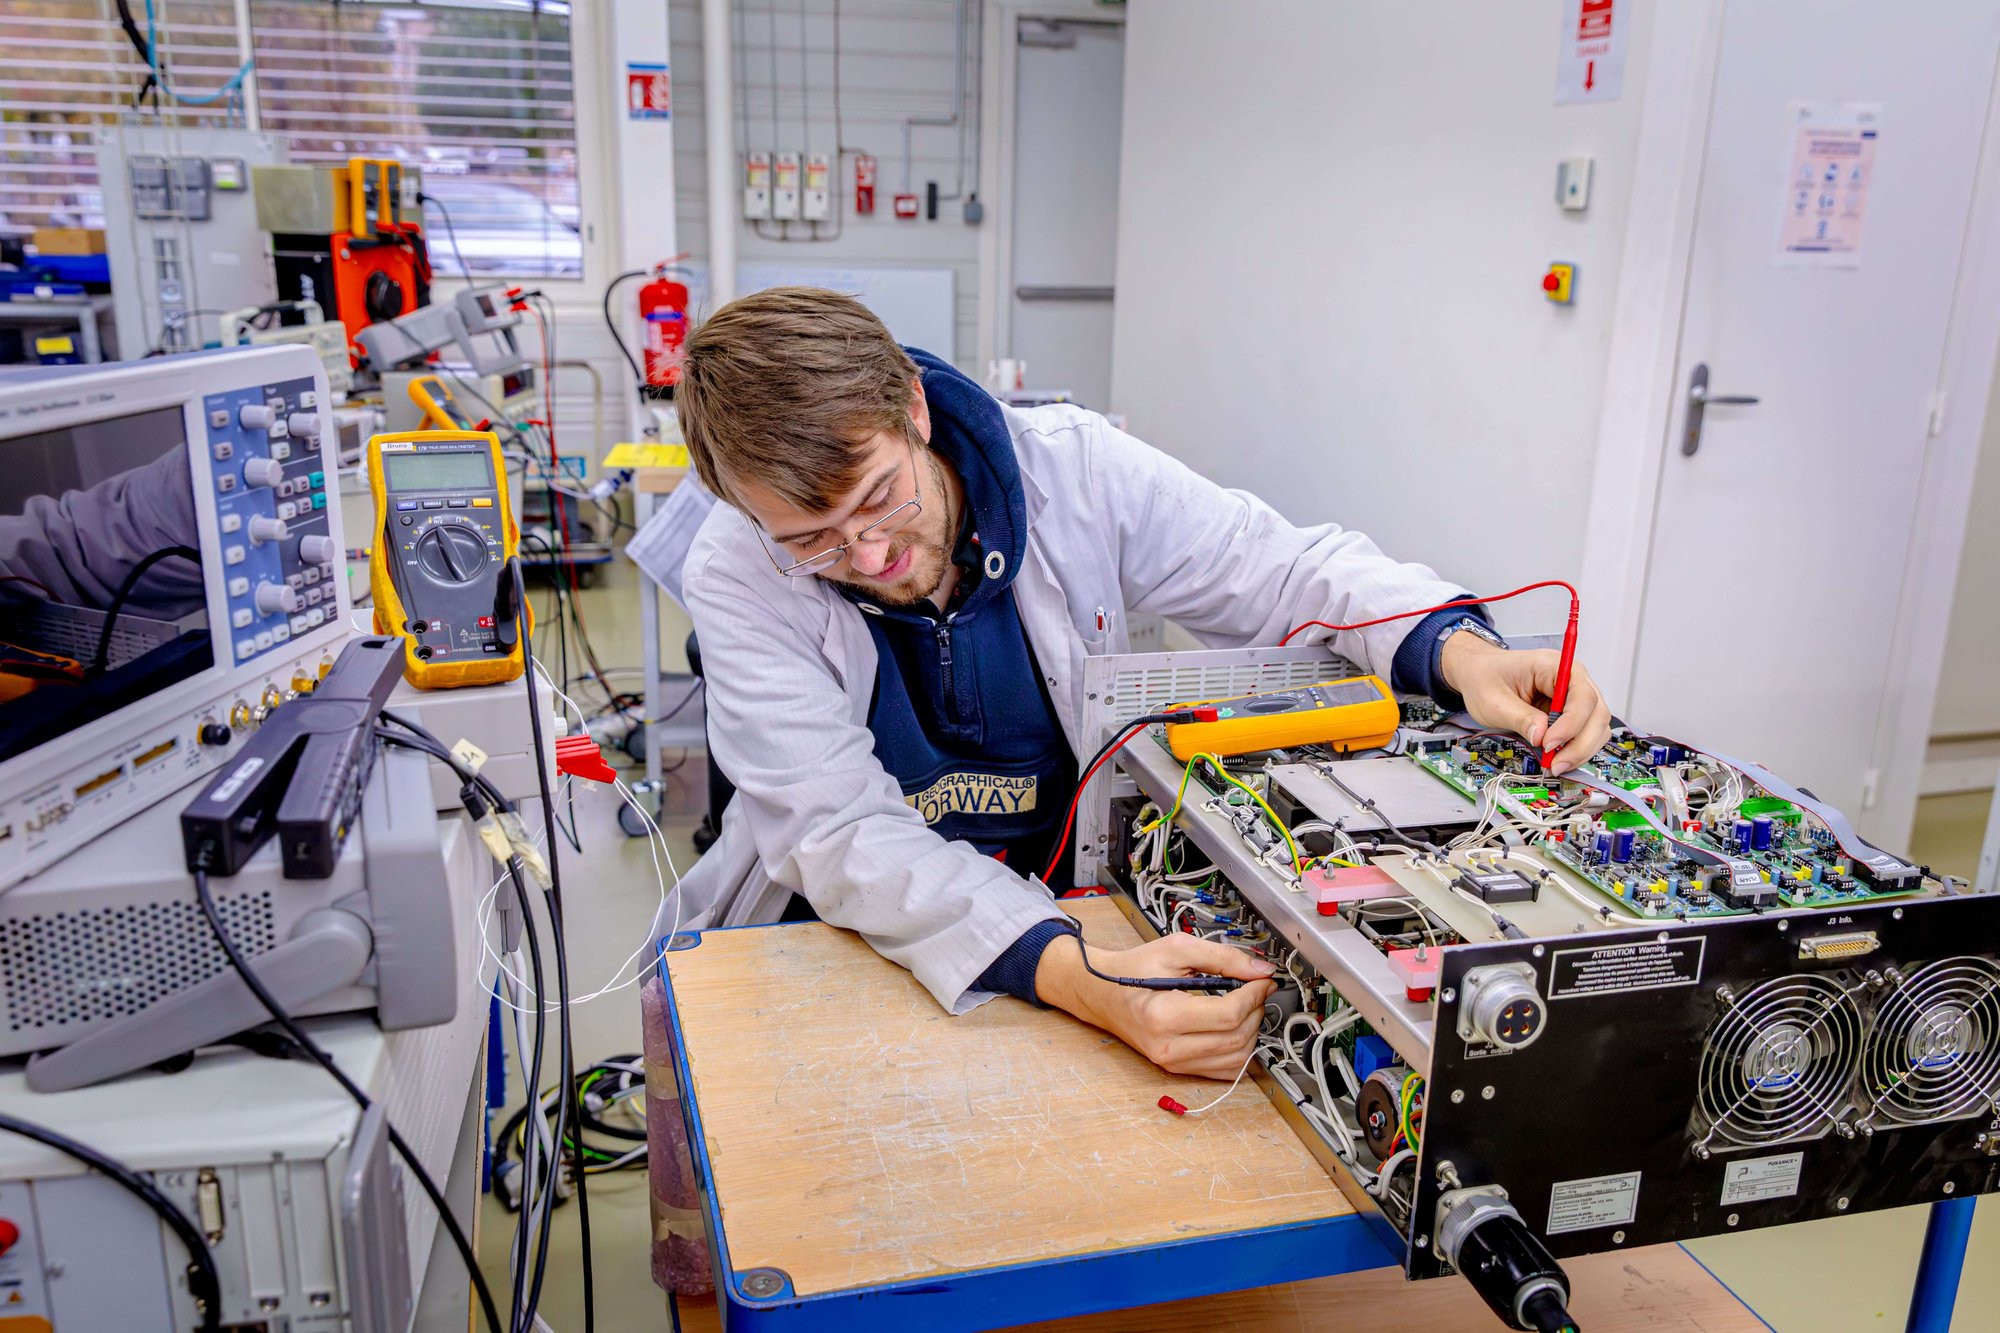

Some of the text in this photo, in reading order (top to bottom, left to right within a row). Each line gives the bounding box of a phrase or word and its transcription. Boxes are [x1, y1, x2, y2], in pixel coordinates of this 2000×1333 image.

[1828, 916, 1853, 925] J3 Info.
[1592, 944, 1667, 958] ATTENTION Warning
